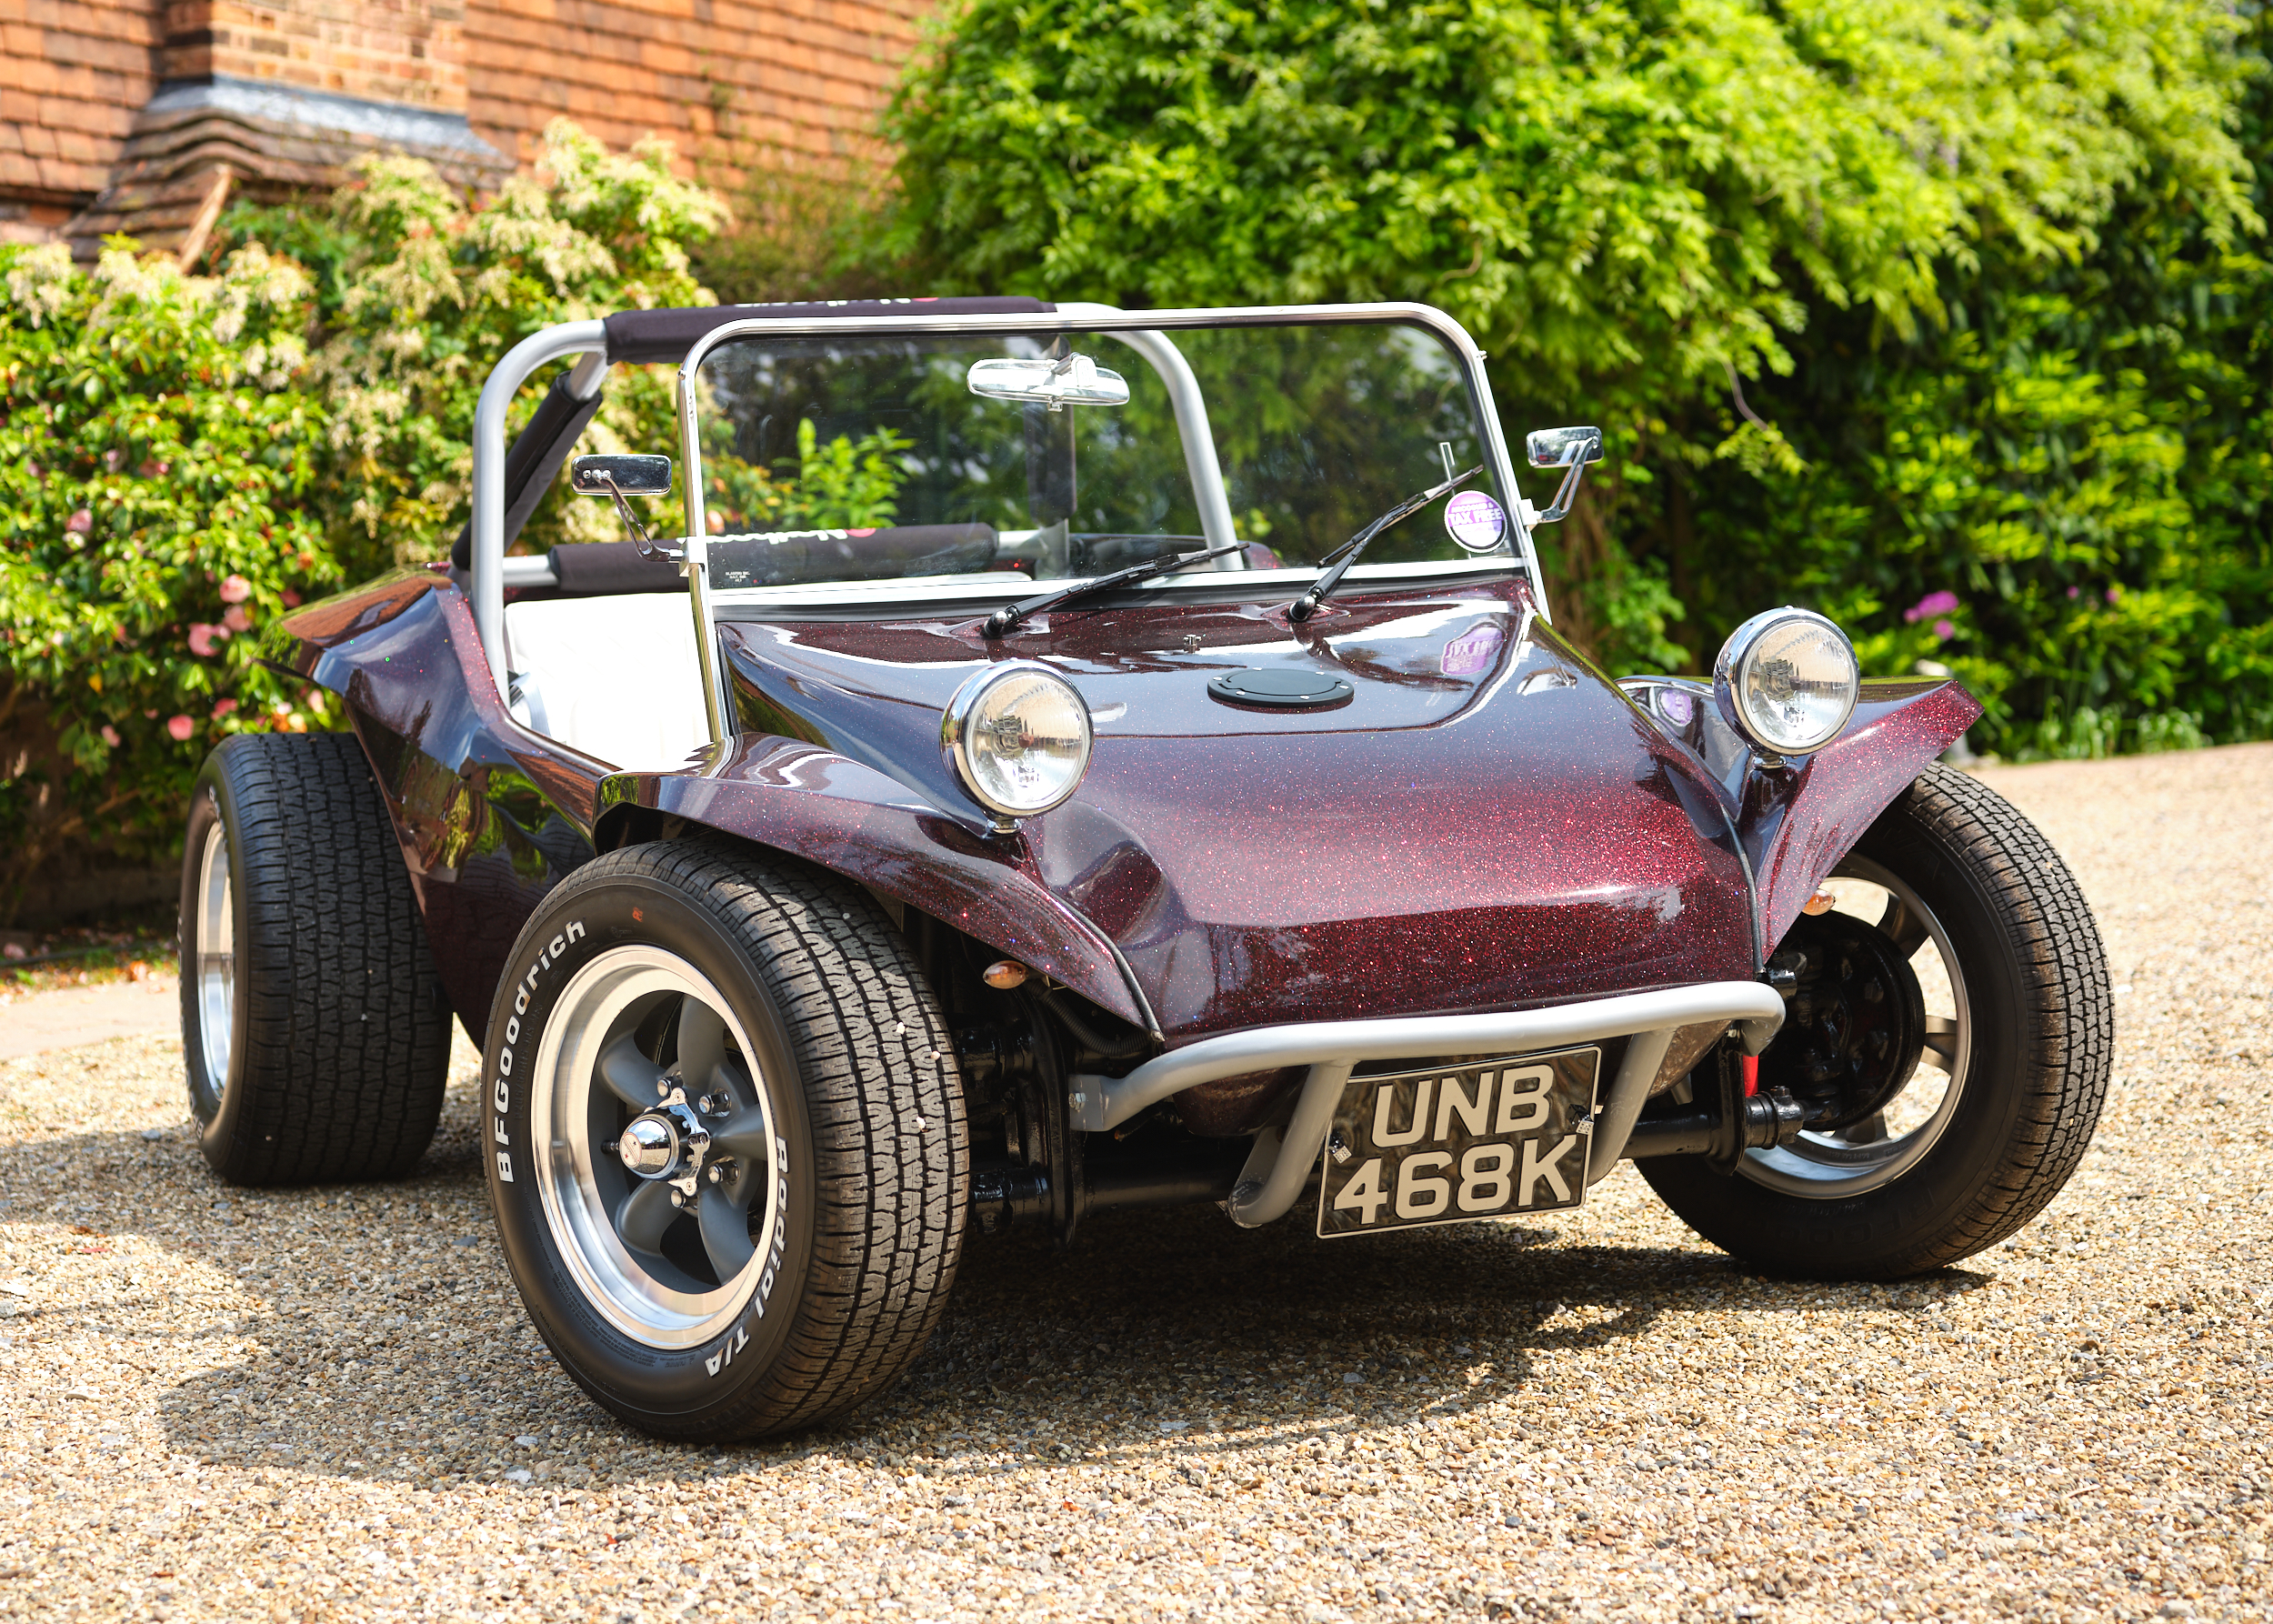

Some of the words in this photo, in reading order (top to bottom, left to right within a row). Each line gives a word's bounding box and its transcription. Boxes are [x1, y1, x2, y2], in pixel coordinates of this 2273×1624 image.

[1447, 511, 1473, 526] TAX
[1473, 507, 1503, 523] FREE
[495, 921, 586, 1182] BFGoodrich
[1372, 1064, 1555, 1148] UNB
[1334, 1135, 1577, 1225] 468K
[755, 1137, 788, 1318] Radial
[705, 1327, 750, 1378] T/A
